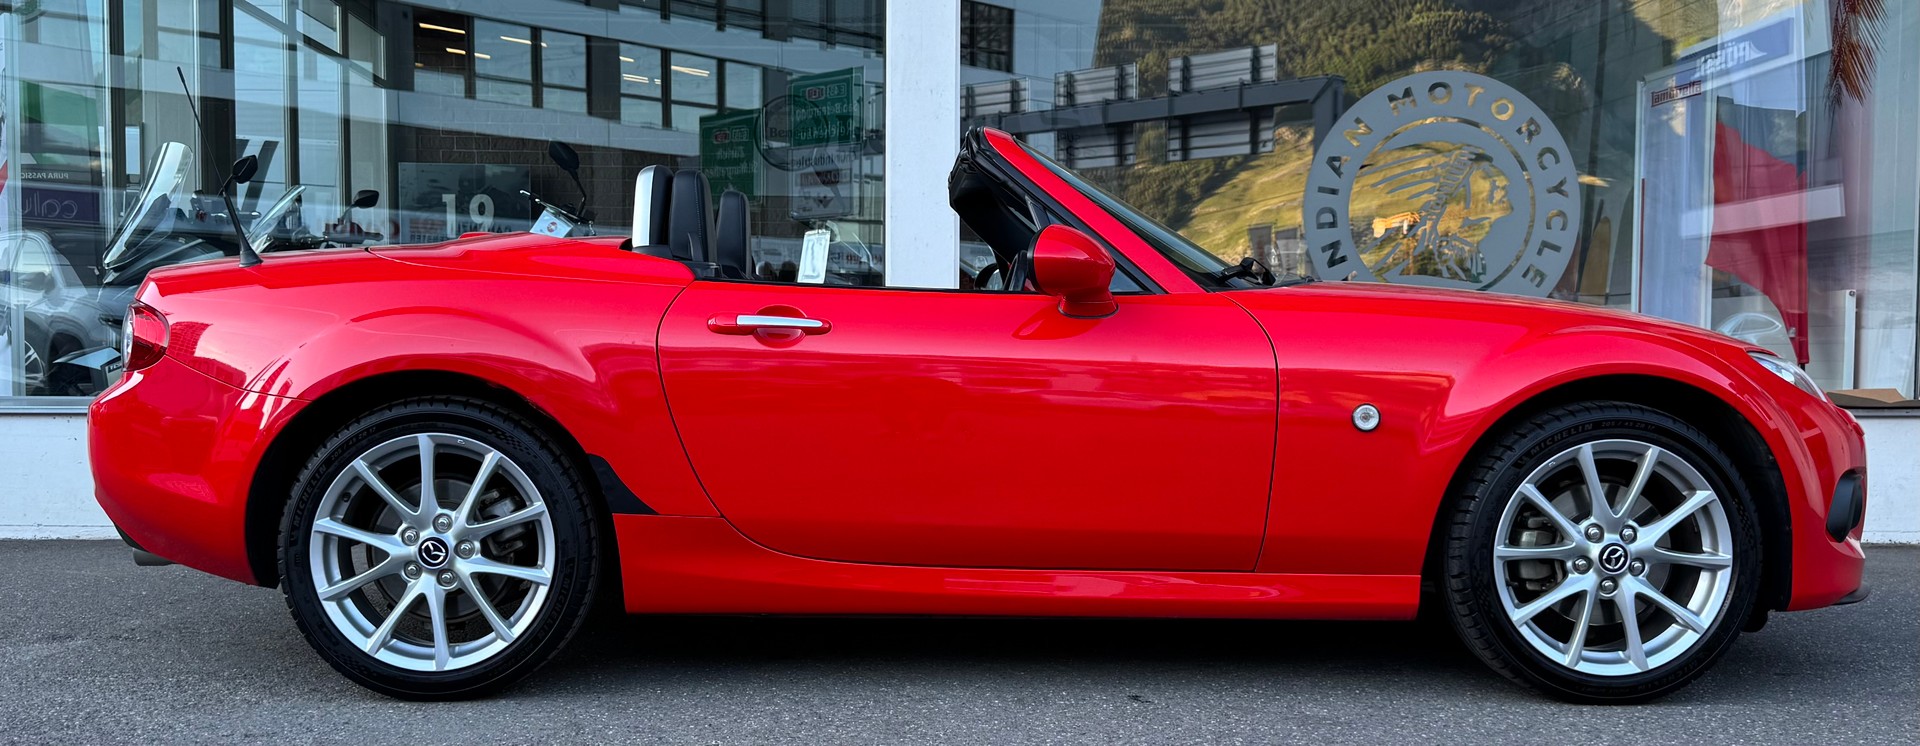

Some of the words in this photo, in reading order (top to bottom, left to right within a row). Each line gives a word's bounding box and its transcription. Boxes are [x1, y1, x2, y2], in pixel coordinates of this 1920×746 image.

[1387, 81, 1569, 288] MOTORCYCLE
[441, 193, 495, 238] 19
[1530, 423, 1593, 456] MICHELIN
[293, 465, 327, 528] MICHELIN
